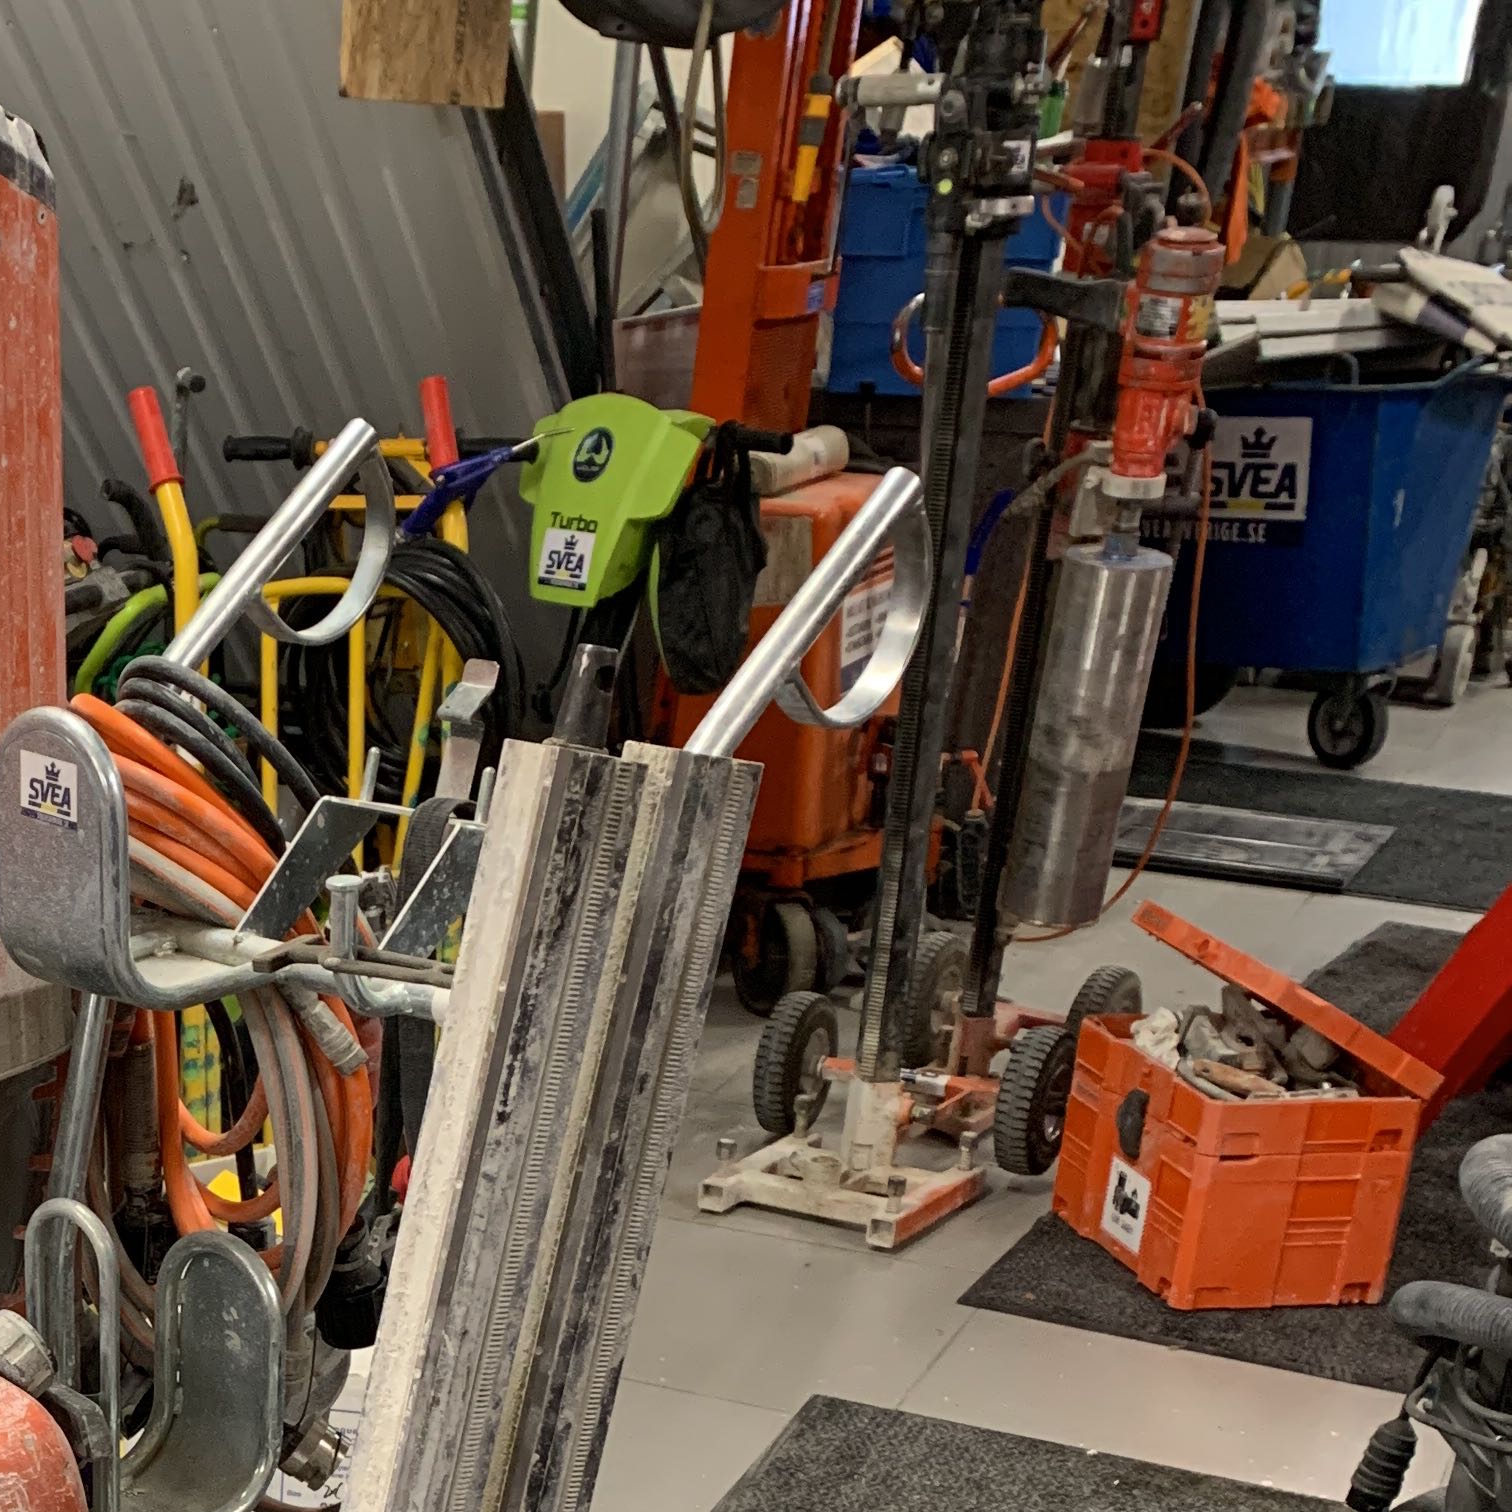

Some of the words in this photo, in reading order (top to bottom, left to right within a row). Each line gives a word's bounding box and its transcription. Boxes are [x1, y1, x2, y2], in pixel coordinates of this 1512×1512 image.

[1211, 461, 1297, 499] SVEA
[551, 511, 599, 534] Turbo
[545, 550, 585, 574] SVEA
[28, 777, 71, 811] SVEA
